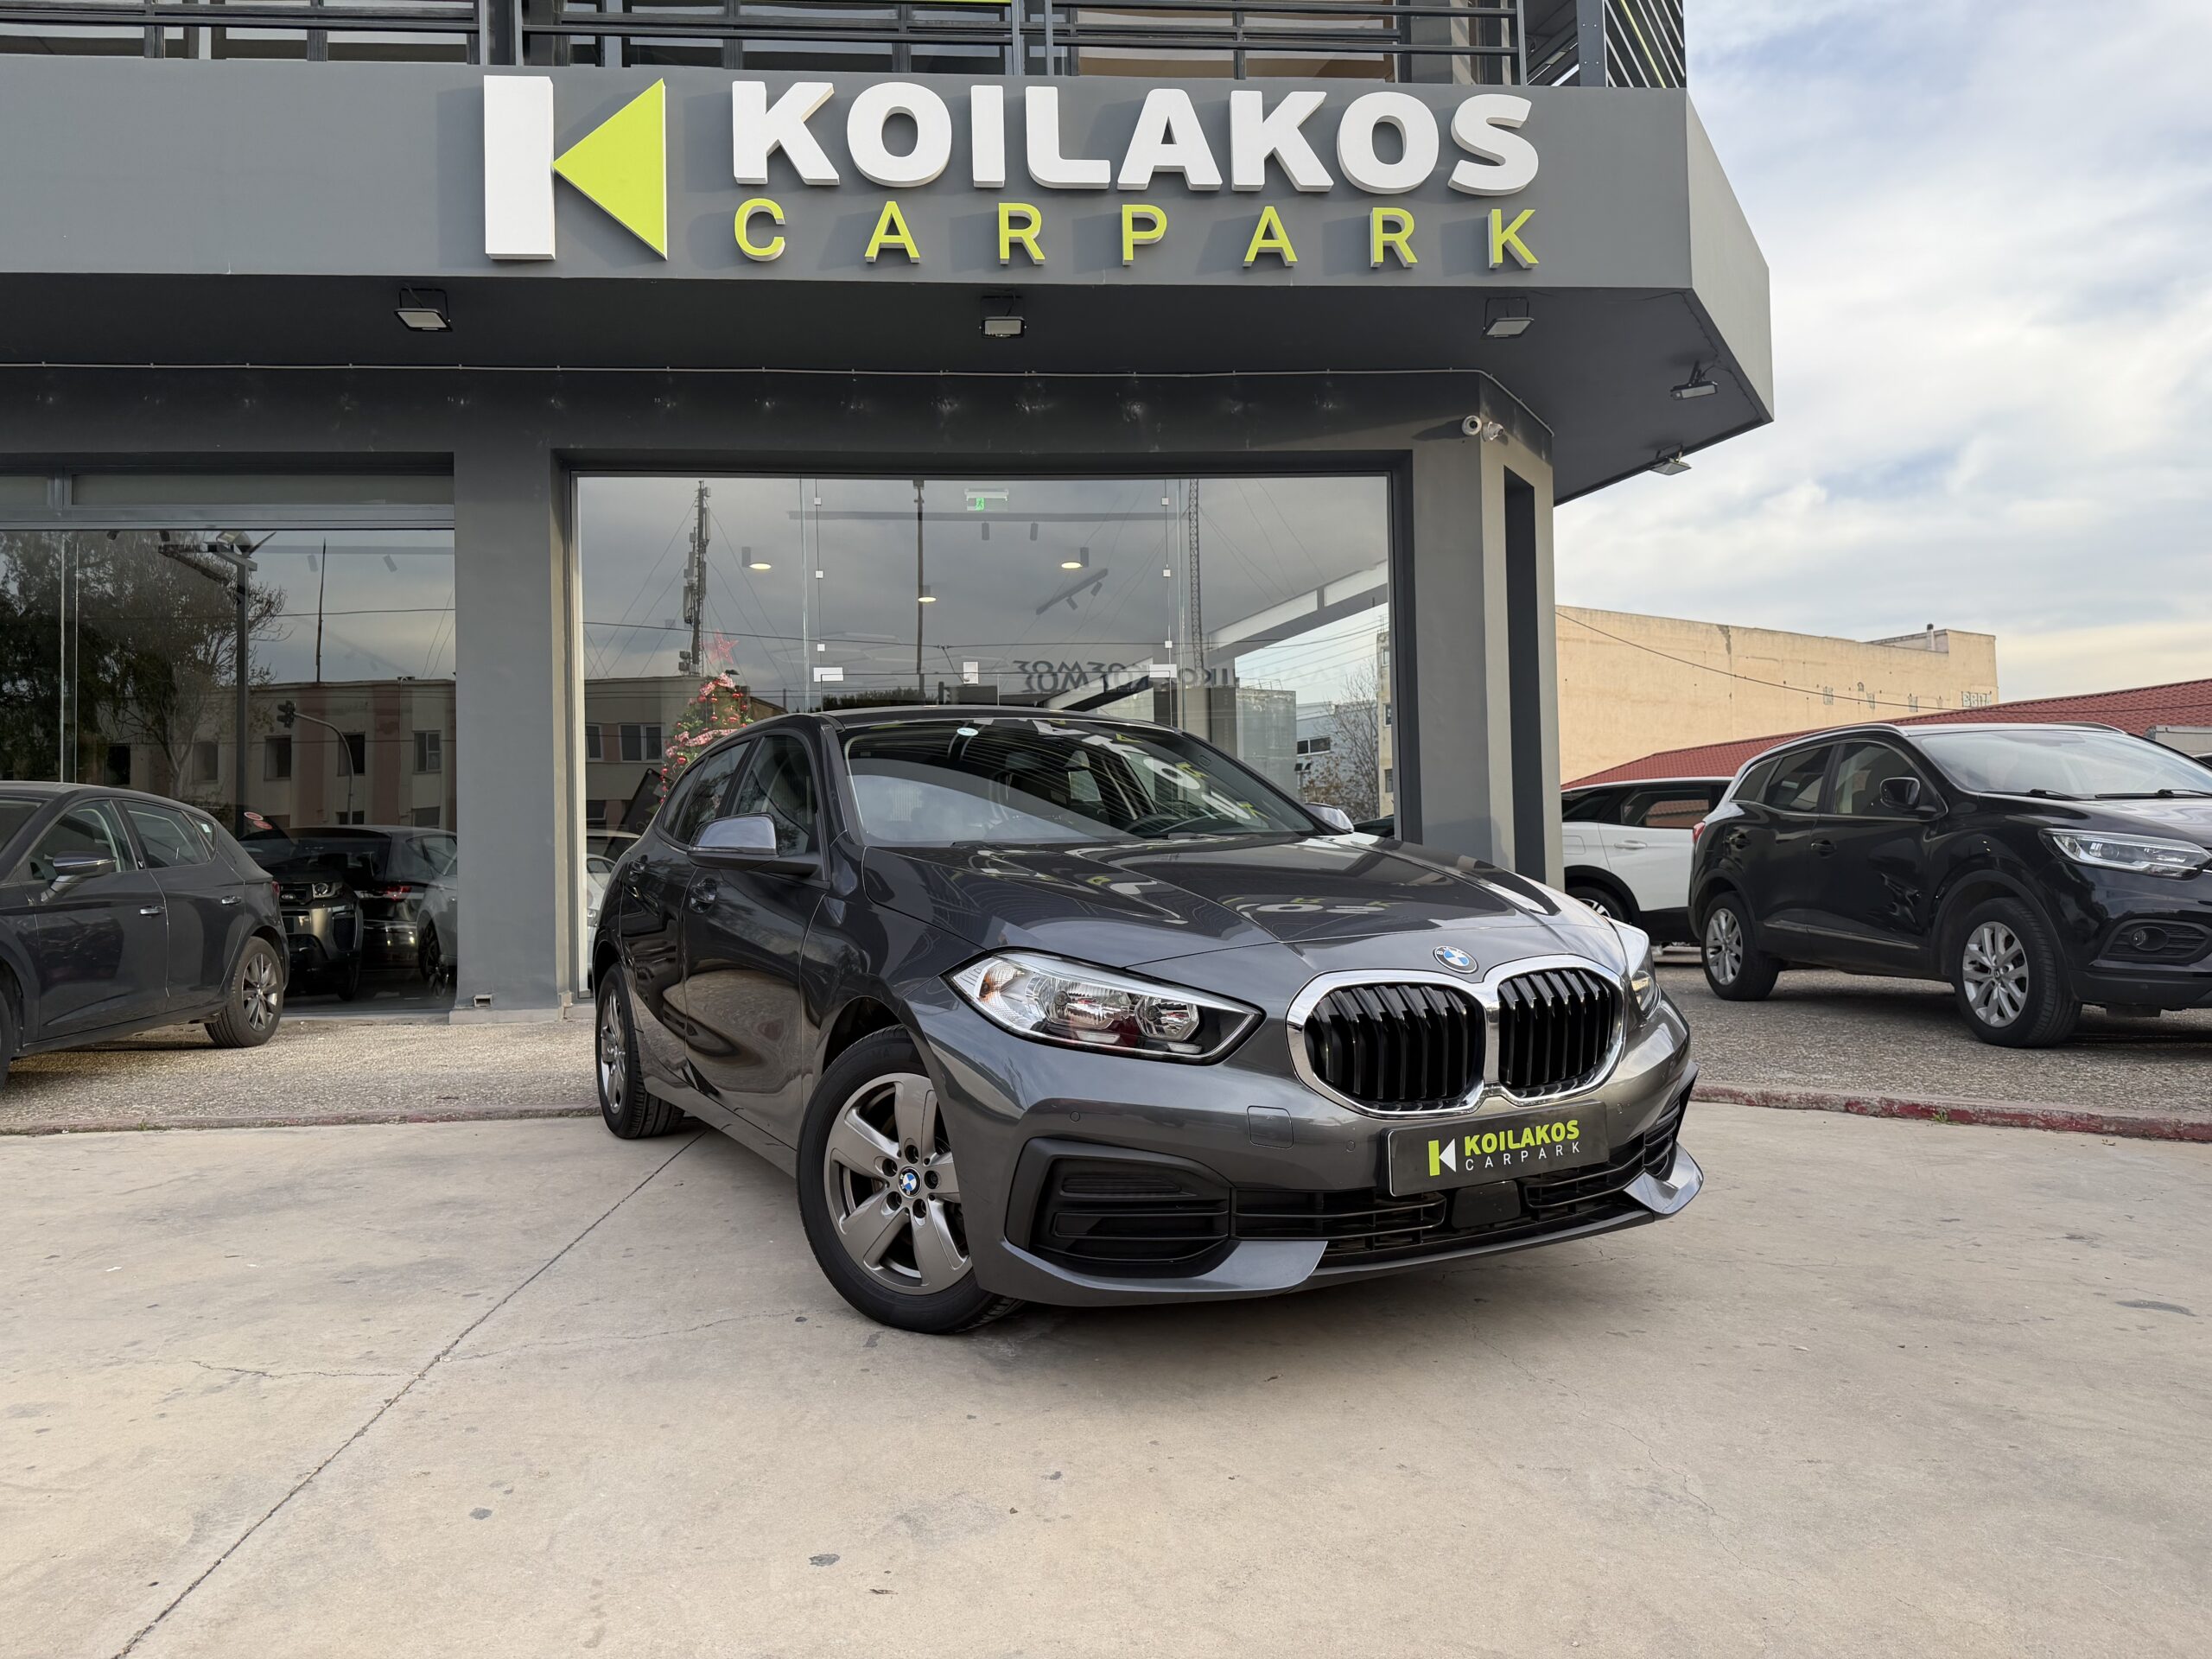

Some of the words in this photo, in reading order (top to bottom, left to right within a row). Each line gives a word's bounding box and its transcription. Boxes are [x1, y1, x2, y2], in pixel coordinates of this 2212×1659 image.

[732, 80, 1539, 196] KOILAKOS
[734, 197, 1540, 270] CARPARK
[1464, 1119, 1580, 1157] KOILAKOS
[1465, 1141, 1581, 1172] CARPARK
